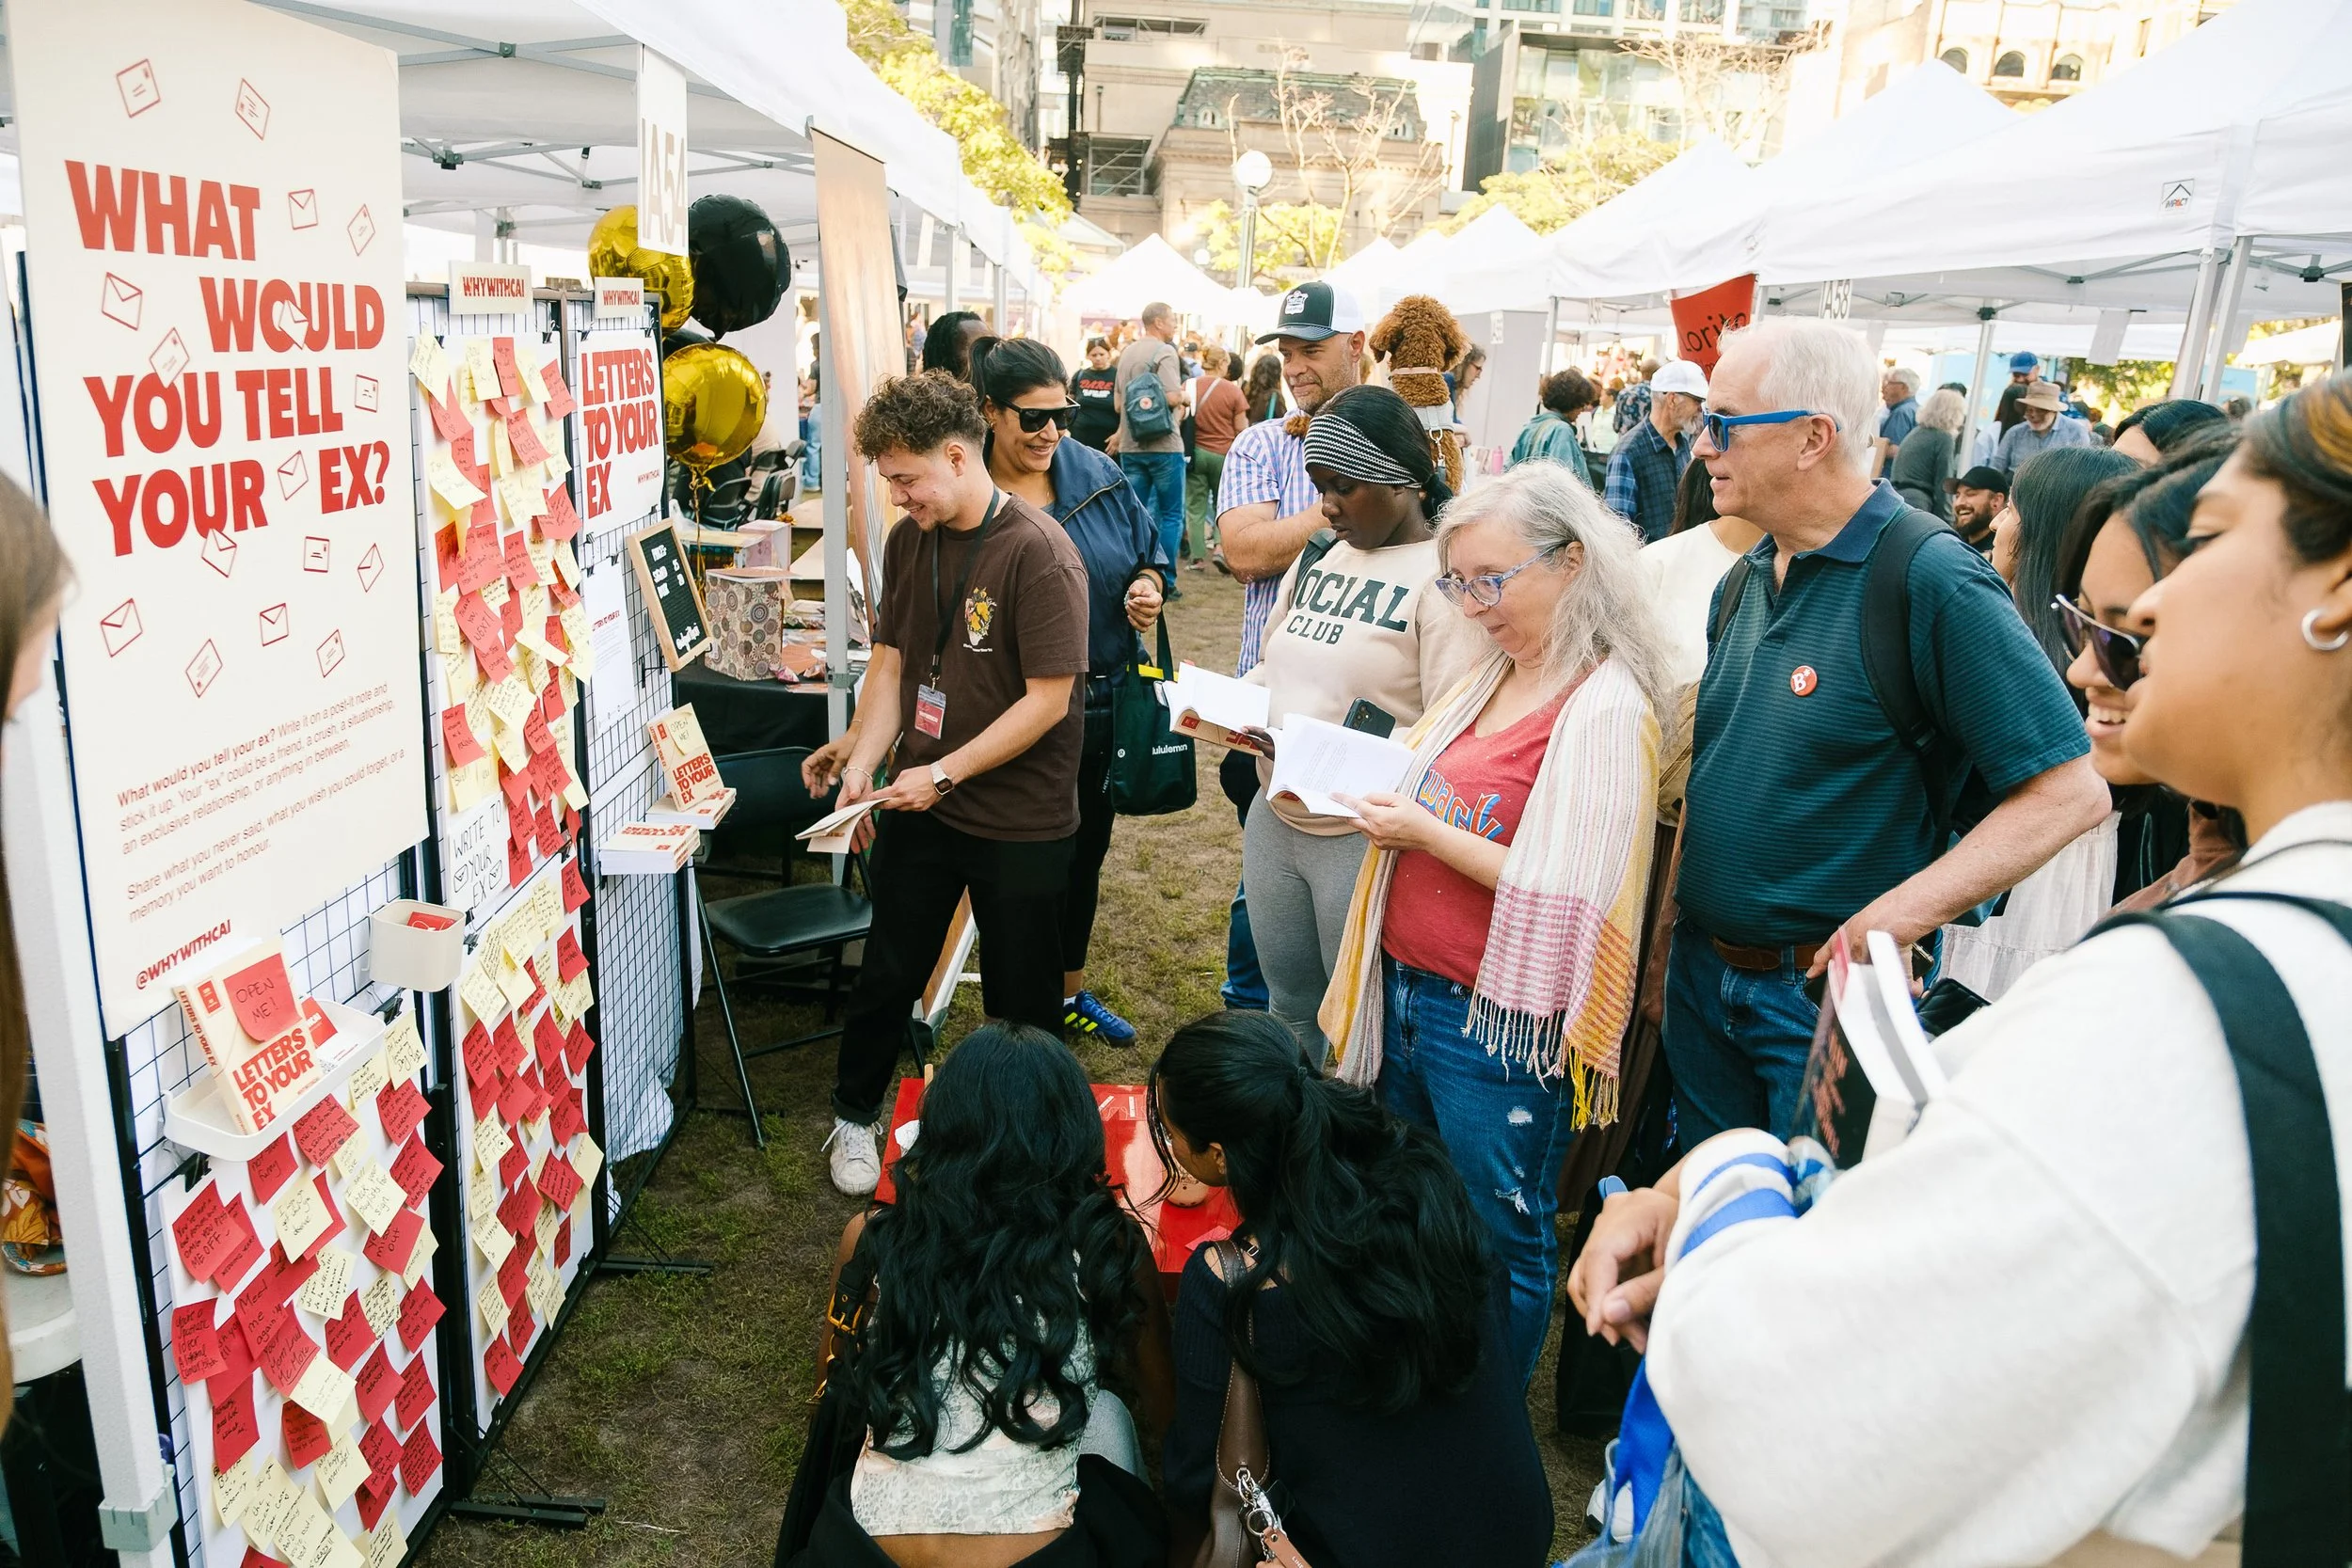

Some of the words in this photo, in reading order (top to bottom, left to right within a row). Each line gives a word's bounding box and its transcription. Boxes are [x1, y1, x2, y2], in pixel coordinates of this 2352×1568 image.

[65, 159, 260, 261] WHAT
[199, 277, 385, 354] WOULD
[463, 277, 525, 297] WHYWITHCAI
[603, 290, 640, 307] WHYWITHCAI
[581, 348, 655, 406] LETTERS
[83, 372, 222, 457] YOU
[236, 366, 342, 441] TELL
[583, 409, 612, 463] TO
[612, 400, 659, 454] YOUR
[91, 459, 265, 557] YOUR
[320, 439, 389, 515] EX?
[586, 461, 612, 519] EX
[1286, 614, 1343, 645] CLUB
[1295, 568, 1410, 633] OCIAL
[118, 784, 150, 807] What
[152, 766, 186, 793] would
[191, 759, 210, 779] you
[215, 748, 230, 766] tell
[232, 740, 255, 761] your
[259, 729, 275, 746] ex?
[278, 721, 300, 737] Write
[303, 715, 308, 726] it
[310, 712, 320, 724] on
[324, 710, 328, 719] a
[330, 696, 354, 718] post-it
[356, 690, 372, 704] note
[374, 682, 388, 697] and
[673, 752, 710, 781] LETTERS
[1152, 743, 1187, 755] lululemon
[120, 811, 145, 832] stick
[150, 804, 155, 817] it
[159, 800, 174, 815] up.
[179, 785, 201, 803] Your
[227, 762, 252, 782] could
[256, 755, 266, 768] be
[269, 752, 275, 763] a
[307, 736, 312, 746] a
[341, 721, 345, 730] a
[122, 839, 136, 854] an
[141, 815, 190, 846] exclusive
[254, 779, 263, 791] or
[266, 760, 303, 785] anything
[306, 755, 312, 766] in
[677, 779, 690, 790] TO
[690, 765, 715, 785] YOUR
[681, 789, 694, 804] EX
[128, 875, 161, 899] Share
[164, 858, 189, 880] what
[192, 848, 210, 869] you
[214, 833, 240, 854] never
[267, 806, 288, 826] what
[291, 800, 306, 817] you
[308, 788, 326, 805] wish
[328, 781, 342, 798] you
[344, 767, 365, 786] could
[390, 752, 398, 763] or
[400, 749, 405, 758] a
[453, 822, 485, 859] WRITE
[489, 800, 502, 831] TO
[130, 890, 173, 923] memory
[177, 879, 196, 899] you
[199, 863, 222, 884] want
[225, 858, 234, 870] to
[237, 839, 271, 863] honour.
[469, 845, 492, 879] YOUR
[472, 880, 488, 909] EX
[136, 919, 230, 990] @WHYWITHCAI
[236, 978, 275, 1003] OPEN
[179, 990, 196, 1022] LETTERS
[194, 1024, 200, 1034] TO
[198, 1034, 213, 1053] YOUR
[208, 1054, 218, 1067] EX
[232, 1028, 306, 1091] LETTERS
[243, 1083, 267, 1112] TO
[263, 1050, 314, 1093] YOUR
[252, 1101, 276, 1131] EX
